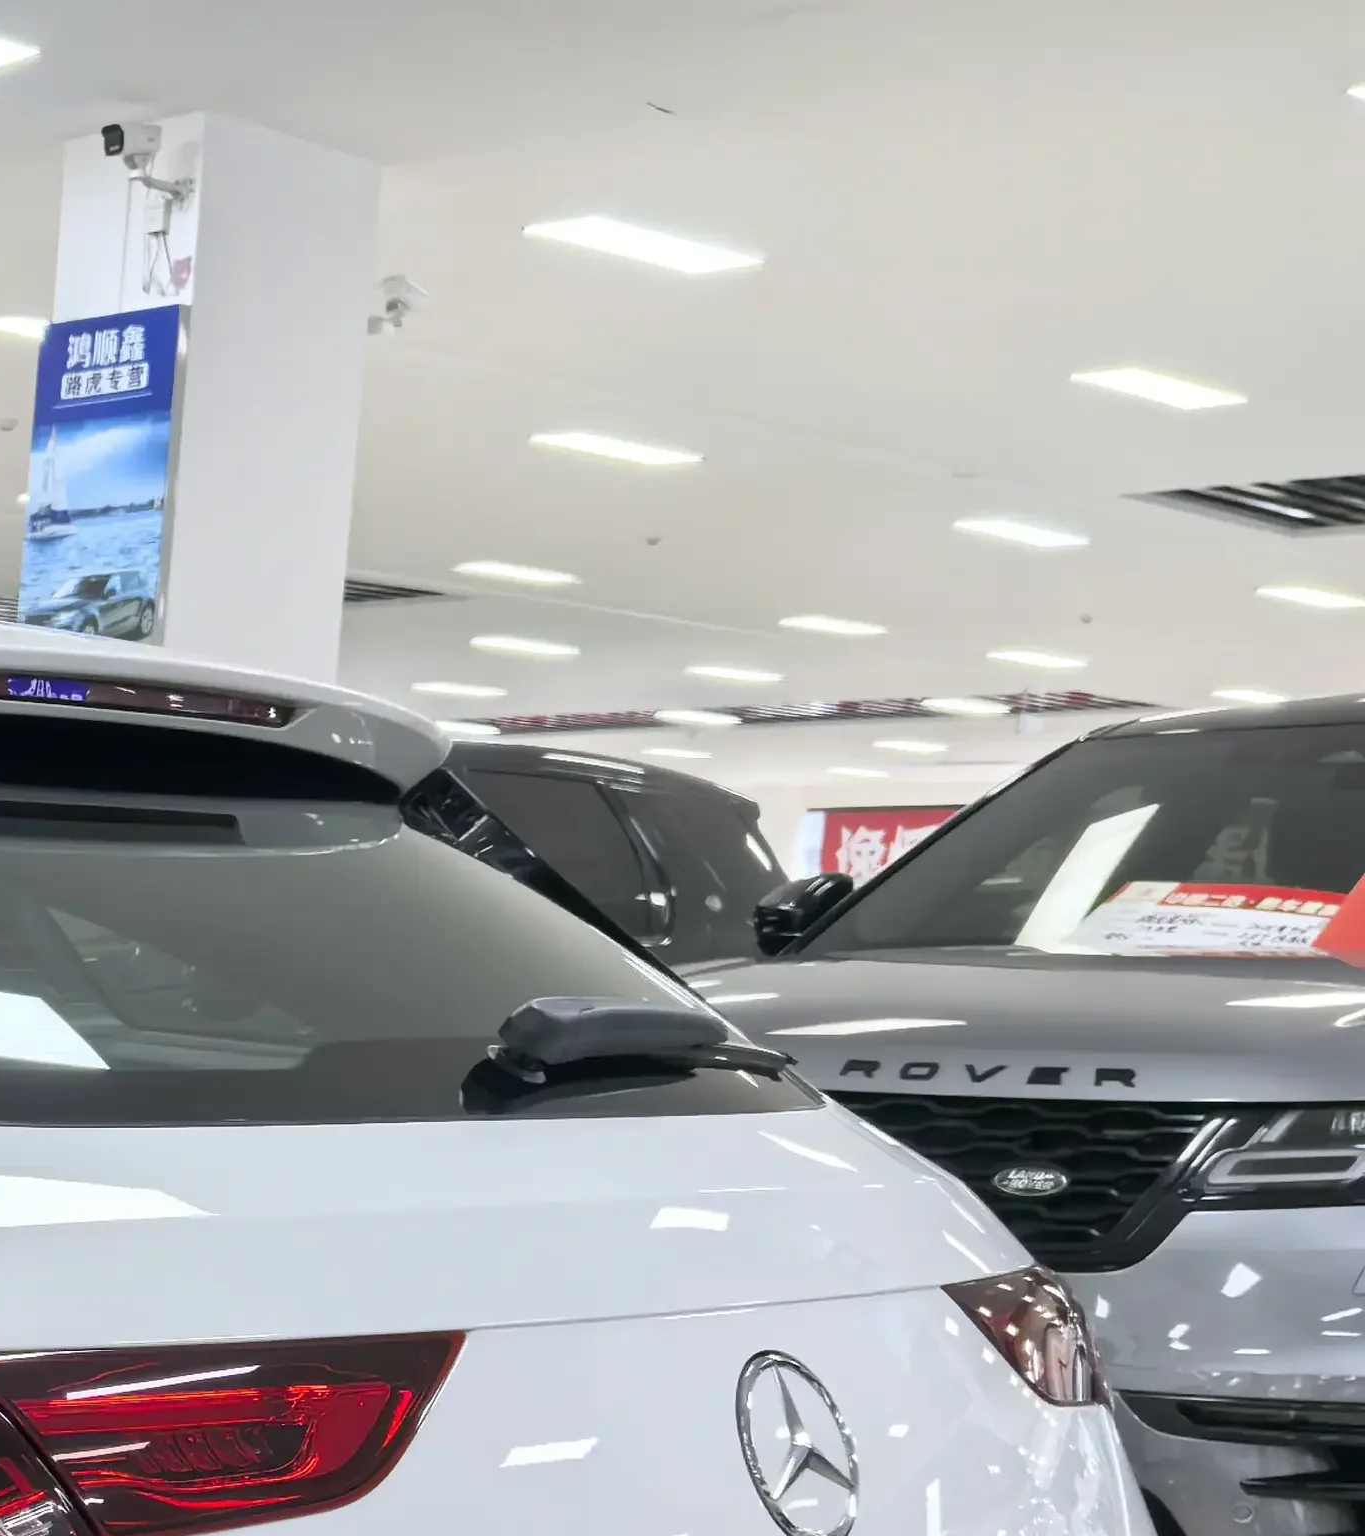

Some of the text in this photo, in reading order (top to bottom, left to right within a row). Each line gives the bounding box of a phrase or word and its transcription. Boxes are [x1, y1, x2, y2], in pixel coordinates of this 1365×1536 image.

[66, 324, 145, 369] 鸿顺鑫
[65, 366, 144, 396] 路虎专营
[839, 1058, 1137, 1088] ROVER
